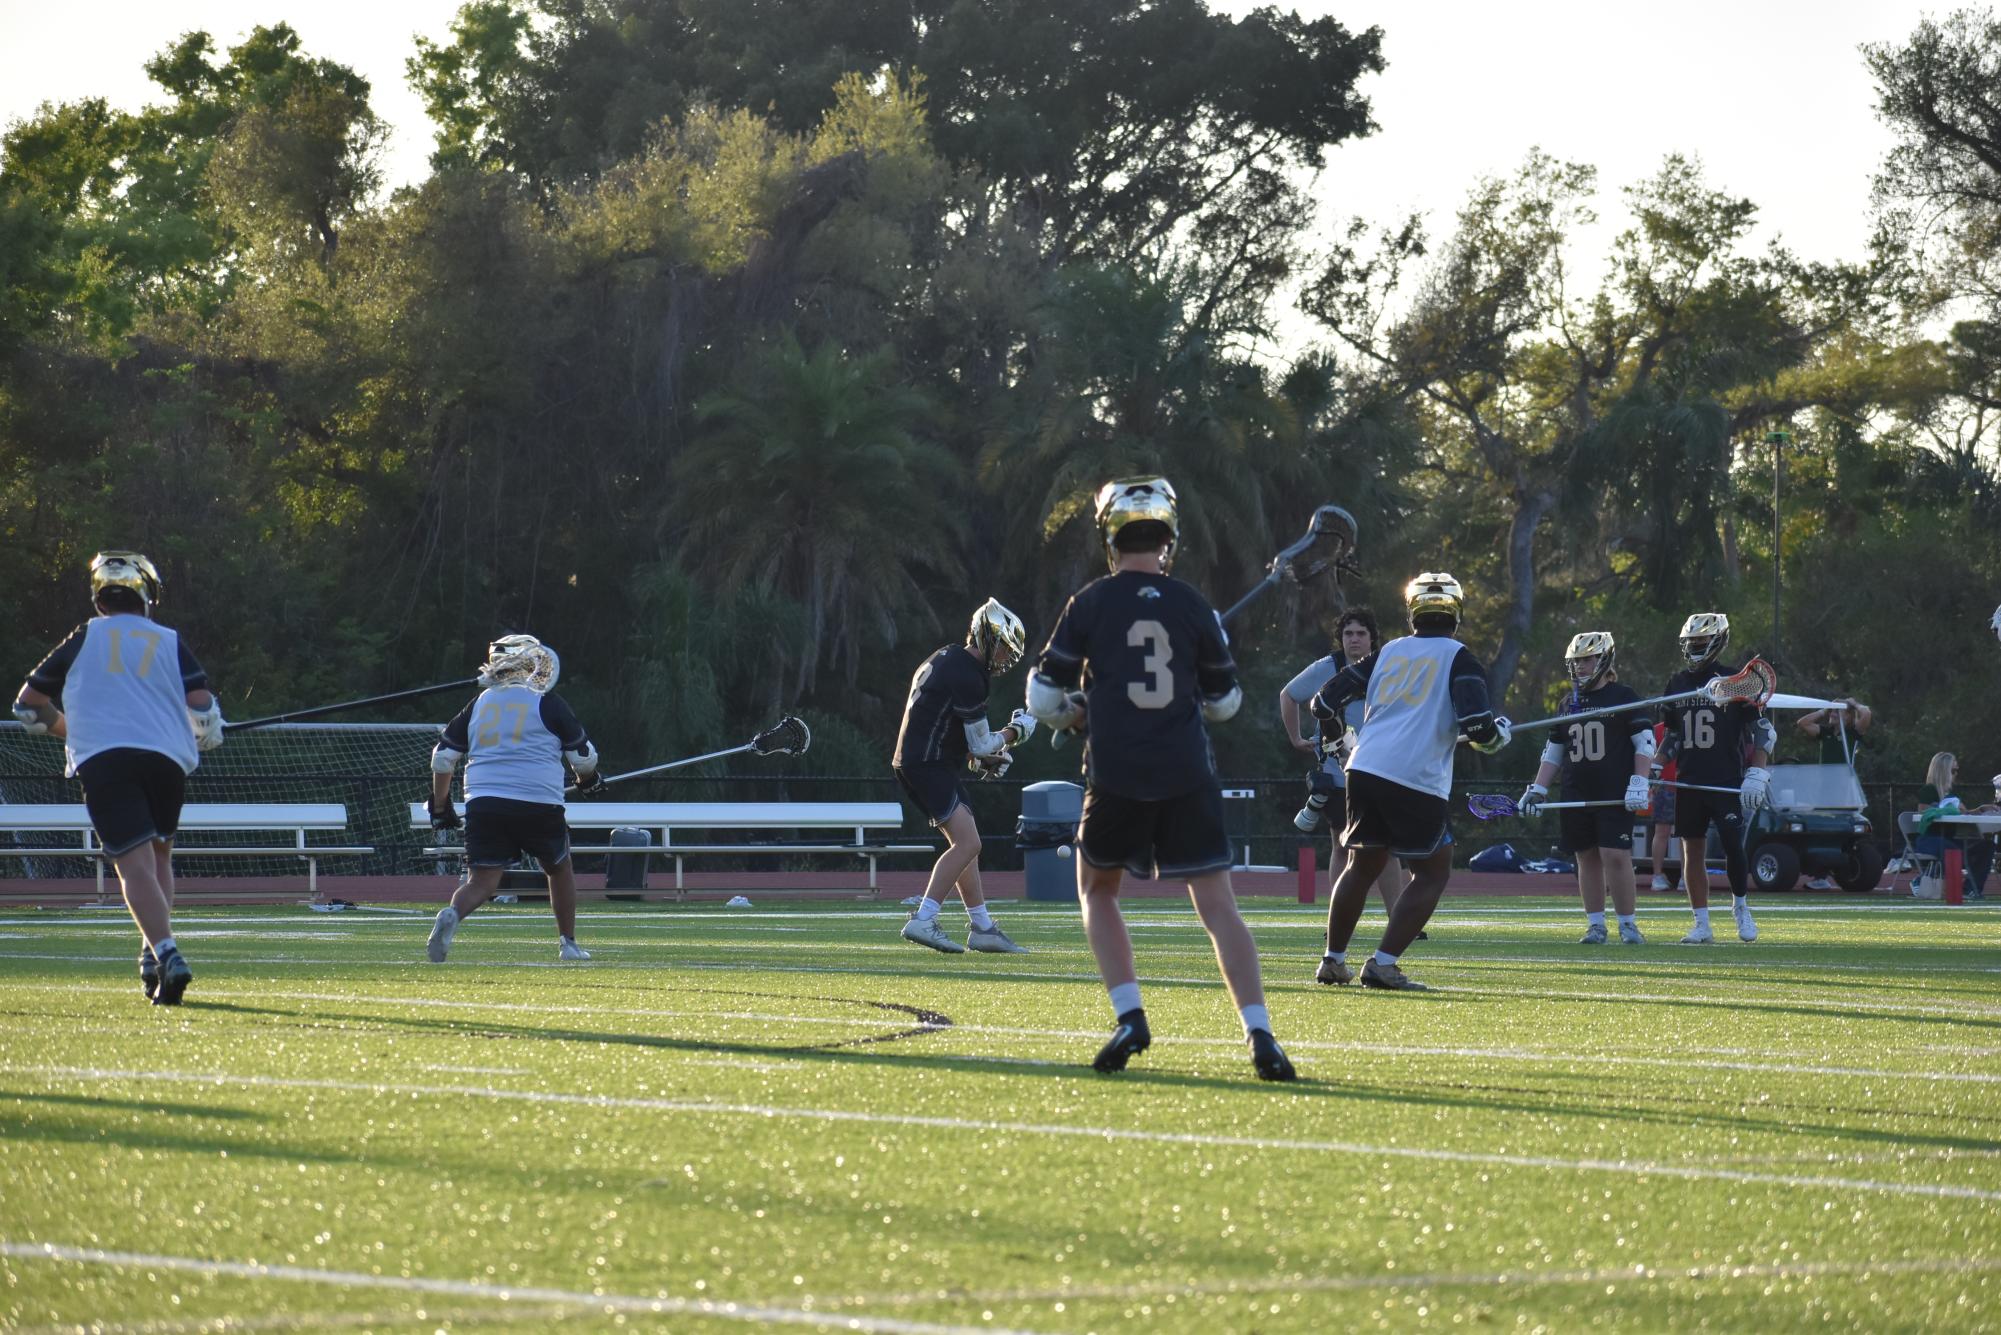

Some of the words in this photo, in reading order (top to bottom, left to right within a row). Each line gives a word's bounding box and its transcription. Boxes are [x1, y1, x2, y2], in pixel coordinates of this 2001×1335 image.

[107, 628, 161, 677] 17
[1127, 620, 1173, 709] 3
[1379, 655, 1440, 706] 20
[480, 704, 529, 745] 27
[1569, 721, 1605, 762] 30
[1683, 710, 1715, 749] 16
